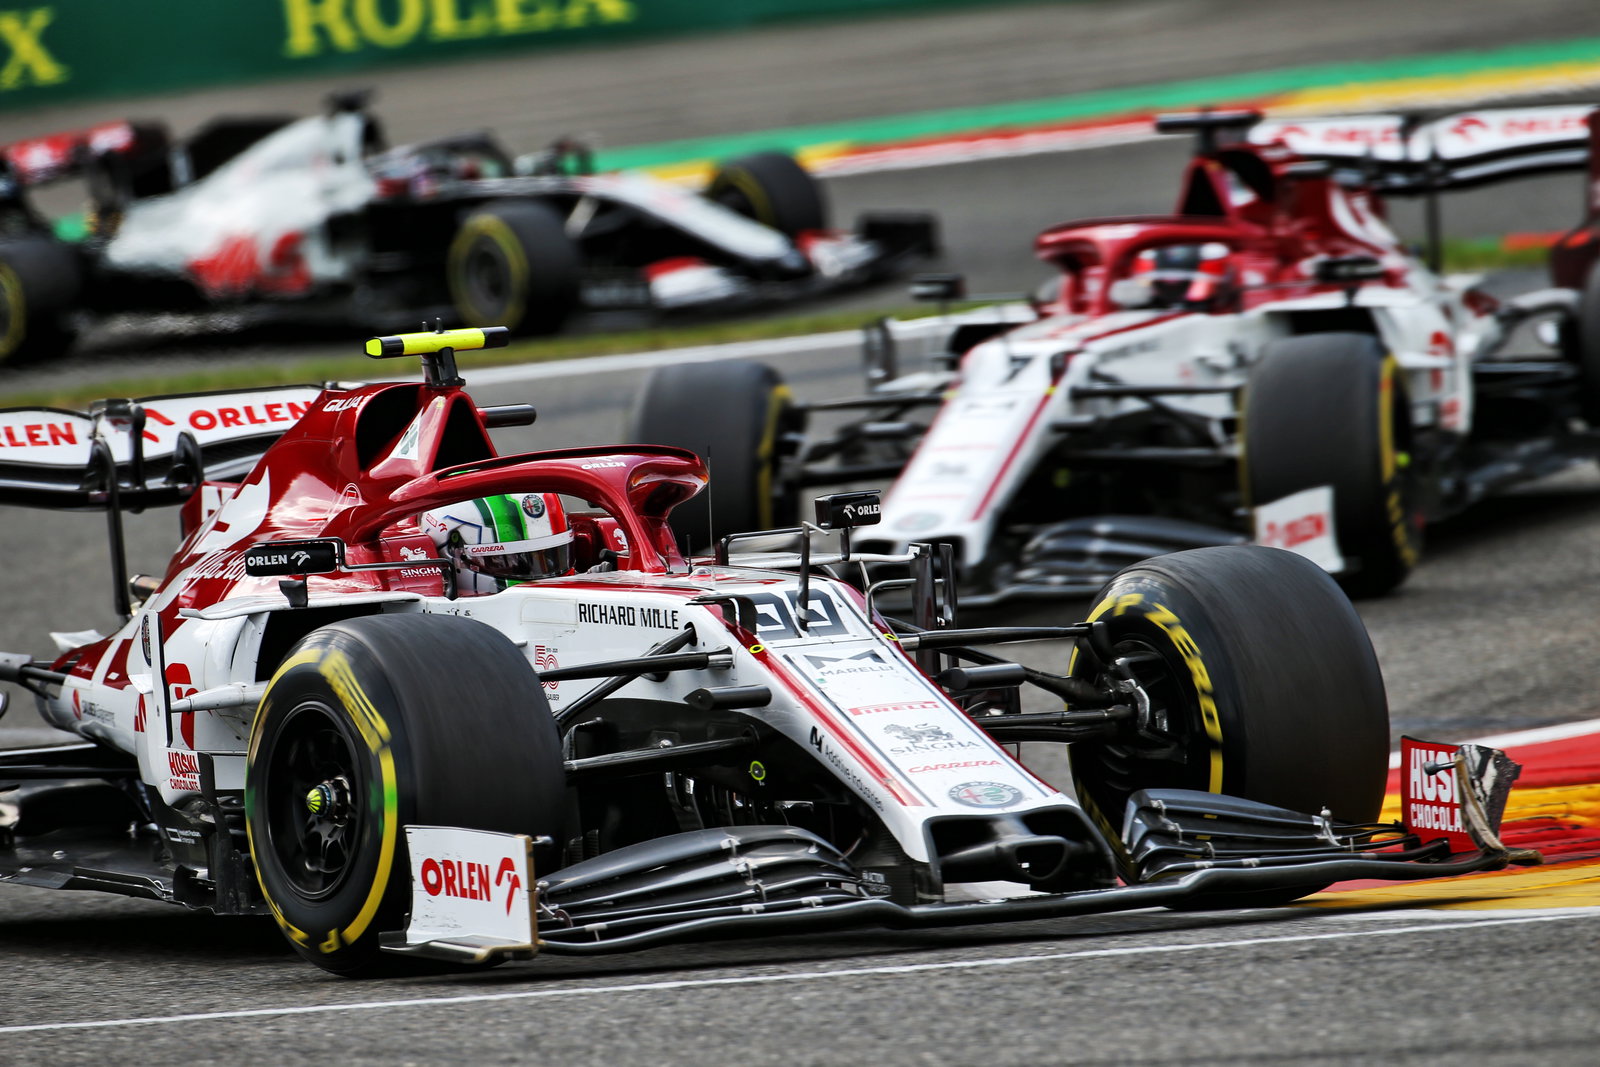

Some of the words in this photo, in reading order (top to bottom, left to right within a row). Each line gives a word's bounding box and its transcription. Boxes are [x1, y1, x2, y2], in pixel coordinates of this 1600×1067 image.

[581, 461, 627, 470] ORLEN
[471, 545, 505, 553] CARRERA
[247, 554, 288, 567] ORLEN
[400, 567, 442, 577] SINGHA
[578, 603, 636, 627] RICHARD
[640, 607, 680, 630] MILLE
[820, 665, 896, 677] MARELLI
[848, 700, 941, 716] PIRELLI
[890, 740, 981, 754] SINGHA
[908, 760, 1003, 774] CARRERA
[1410, 803, 1468, 834] CHOCOLA
[421, 857, 492, 902] ORLEN
